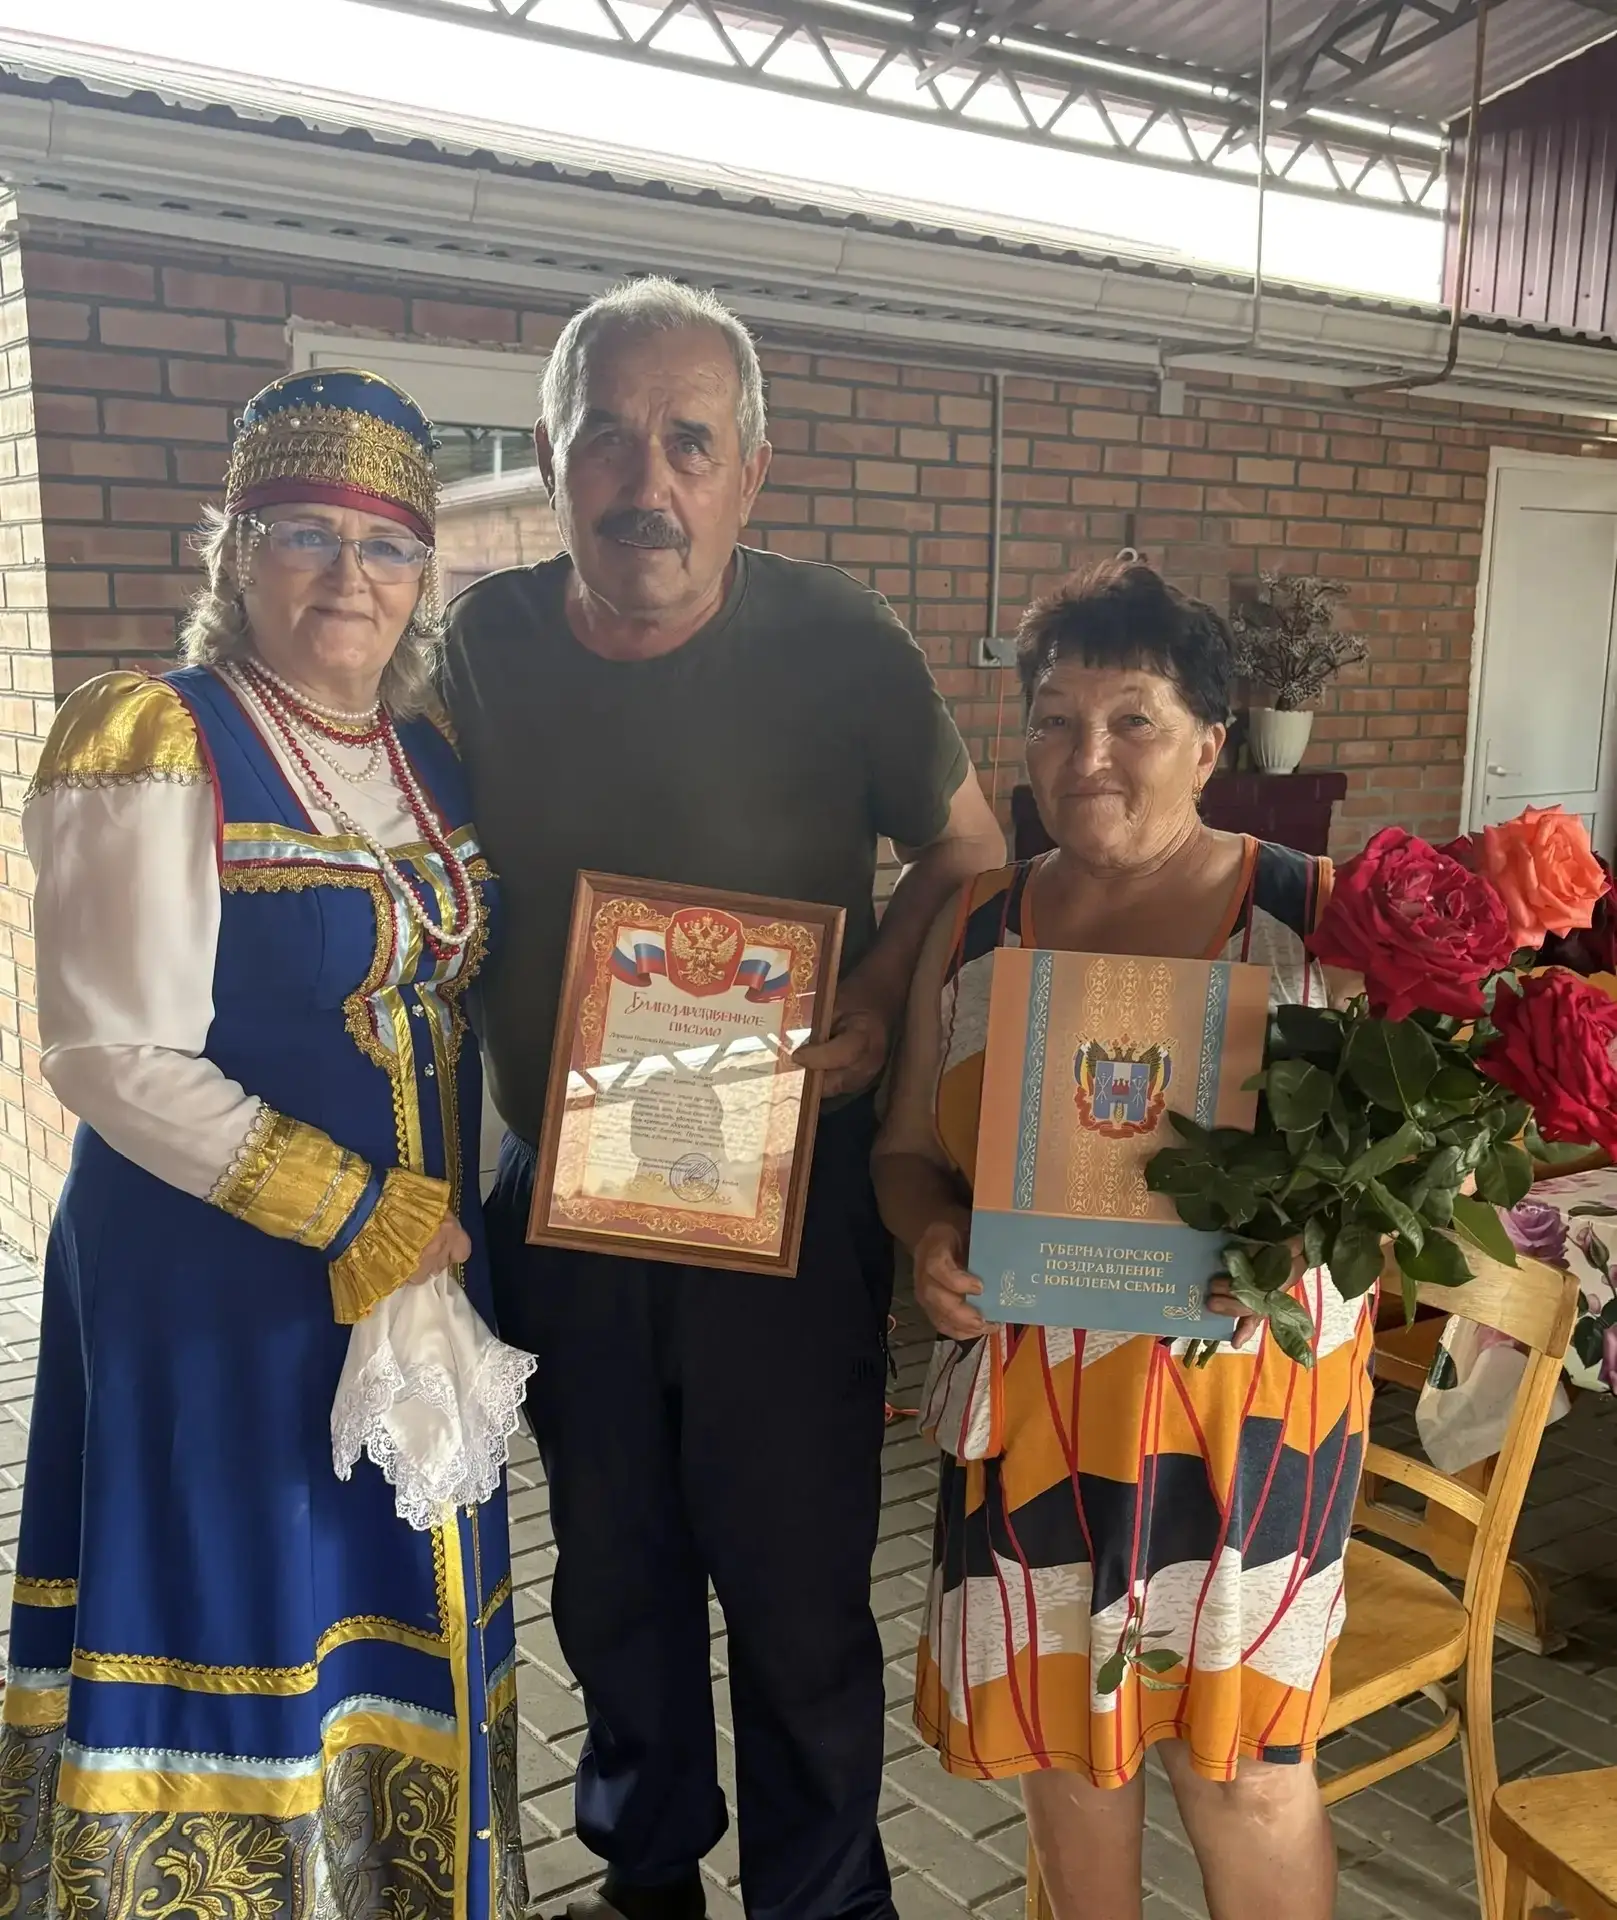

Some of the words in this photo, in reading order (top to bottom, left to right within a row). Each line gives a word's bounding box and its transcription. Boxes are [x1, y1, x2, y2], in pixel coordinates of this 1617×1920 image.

[1039, 1242, 1174, 1263] ГУБЕРНАТОРСКОЕ
[1046, 1259, 1165, 1278] ПОЗДРАВЛЕНИЕ
[1031, 1273, 1040, 1284] С
[1044, 1274, 1121, 1291] ЮБИЛЕЕМ
[1124, 1280, 1177, 1294] СЕМЬИ
